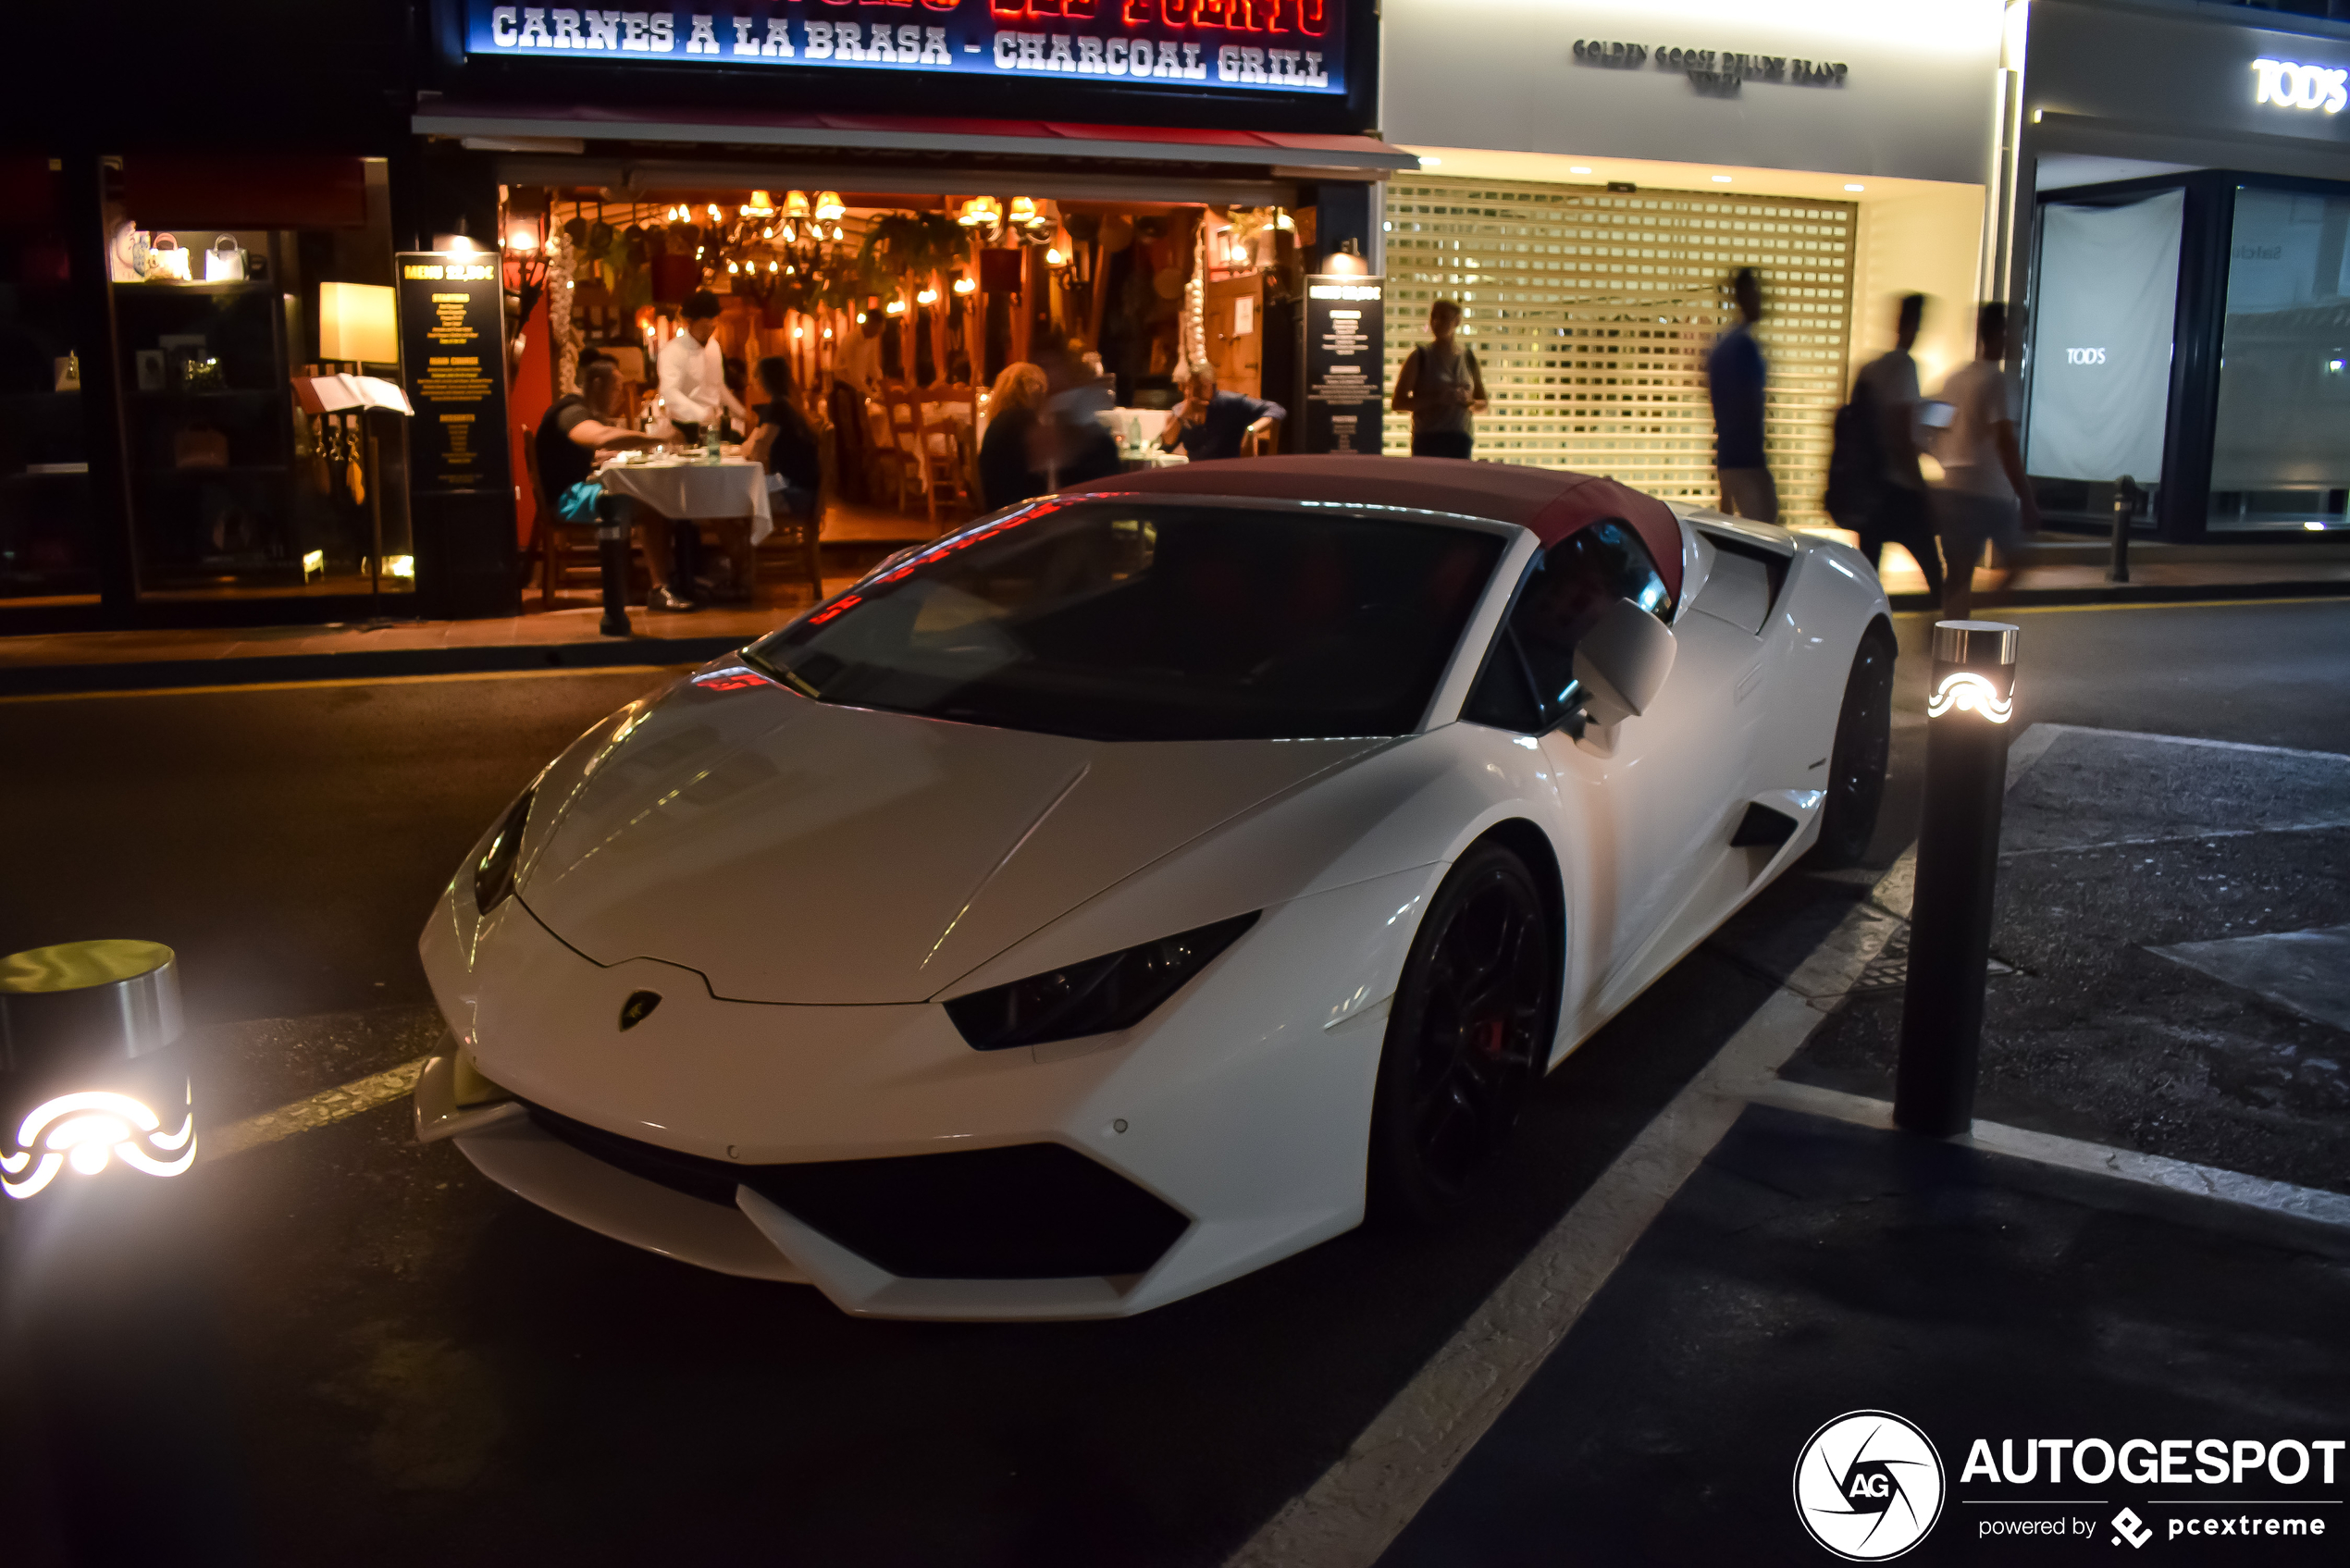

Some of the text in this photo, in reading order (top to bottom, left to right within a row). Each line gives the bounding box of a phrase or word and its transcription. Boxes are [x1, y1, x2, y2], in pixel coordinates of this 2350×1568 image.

[491, 6, 674, 53] CARNES
[686, 15, 721, 55] A
[733, 17, 796, 58] LA
[803, 21, 952, 66] BRASA
[993, 31, 1206, 80] CHARCOAL
[1217, 45, 1329, 89] GRILL
[1572, 39, 1649, 67] GOLDEN
